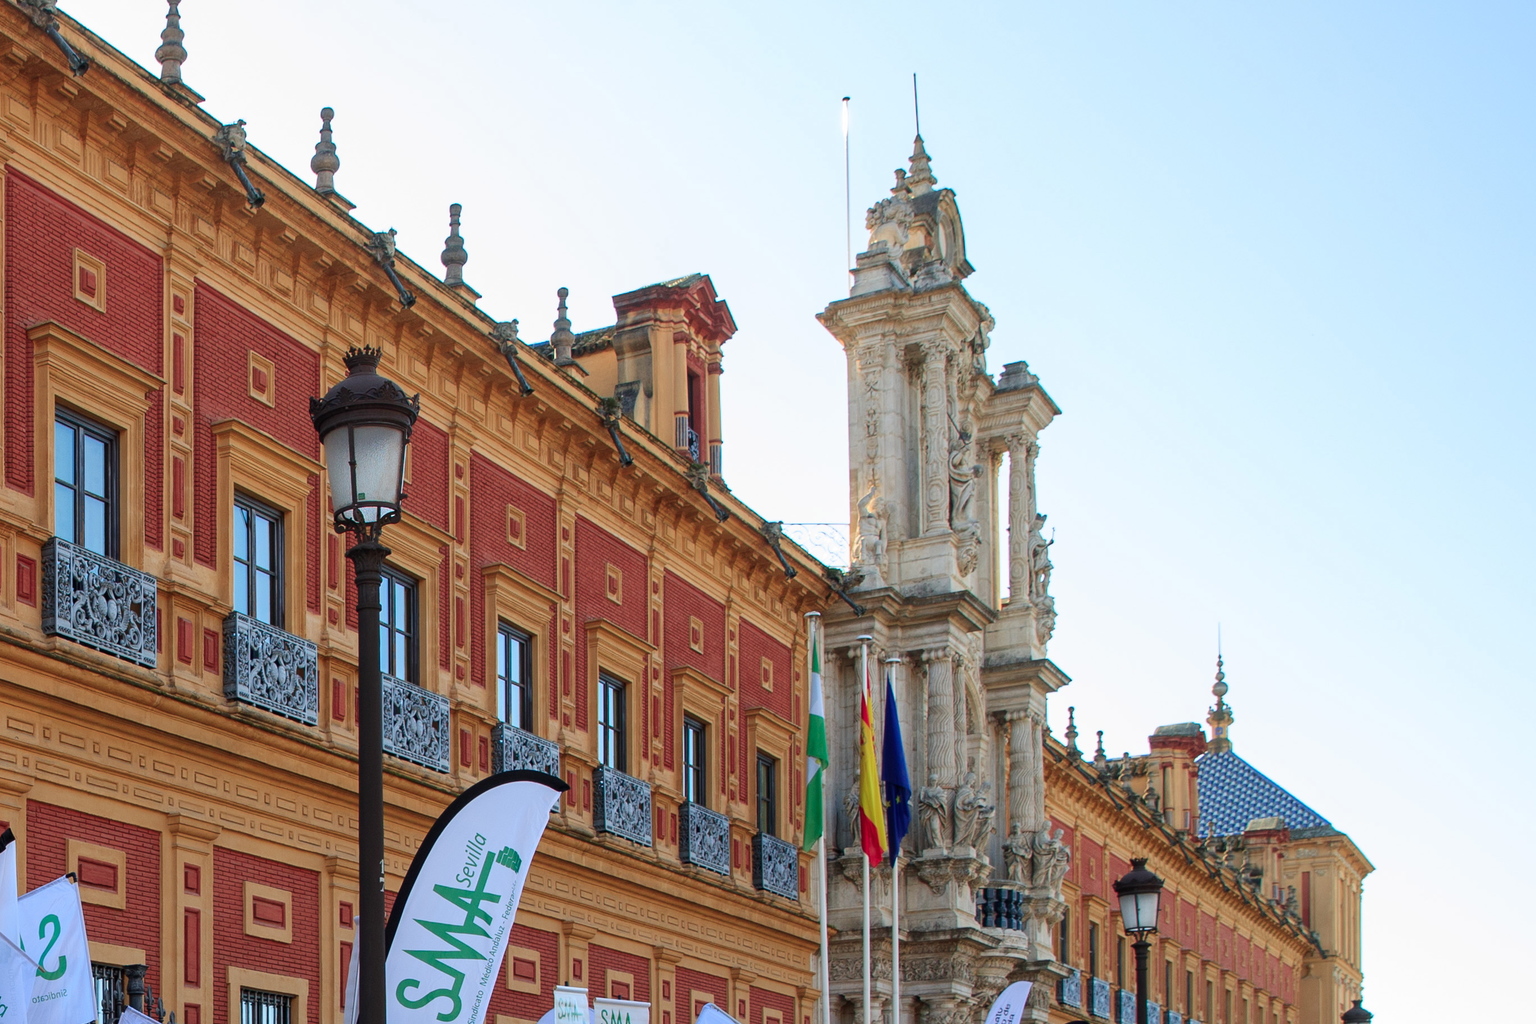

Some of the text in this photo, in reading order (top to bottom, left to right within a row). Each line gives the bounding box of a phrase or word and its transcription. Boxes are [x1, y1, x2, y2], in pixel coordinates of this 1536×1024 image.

[455, 832, 488, 888] Sevilla
[395, 851, 502, 1023] SMA
[479, 957, 495, 987] Médico
[488, 925, 505, 957] Andaluz
[558, 998, 583, 1022] SMA
